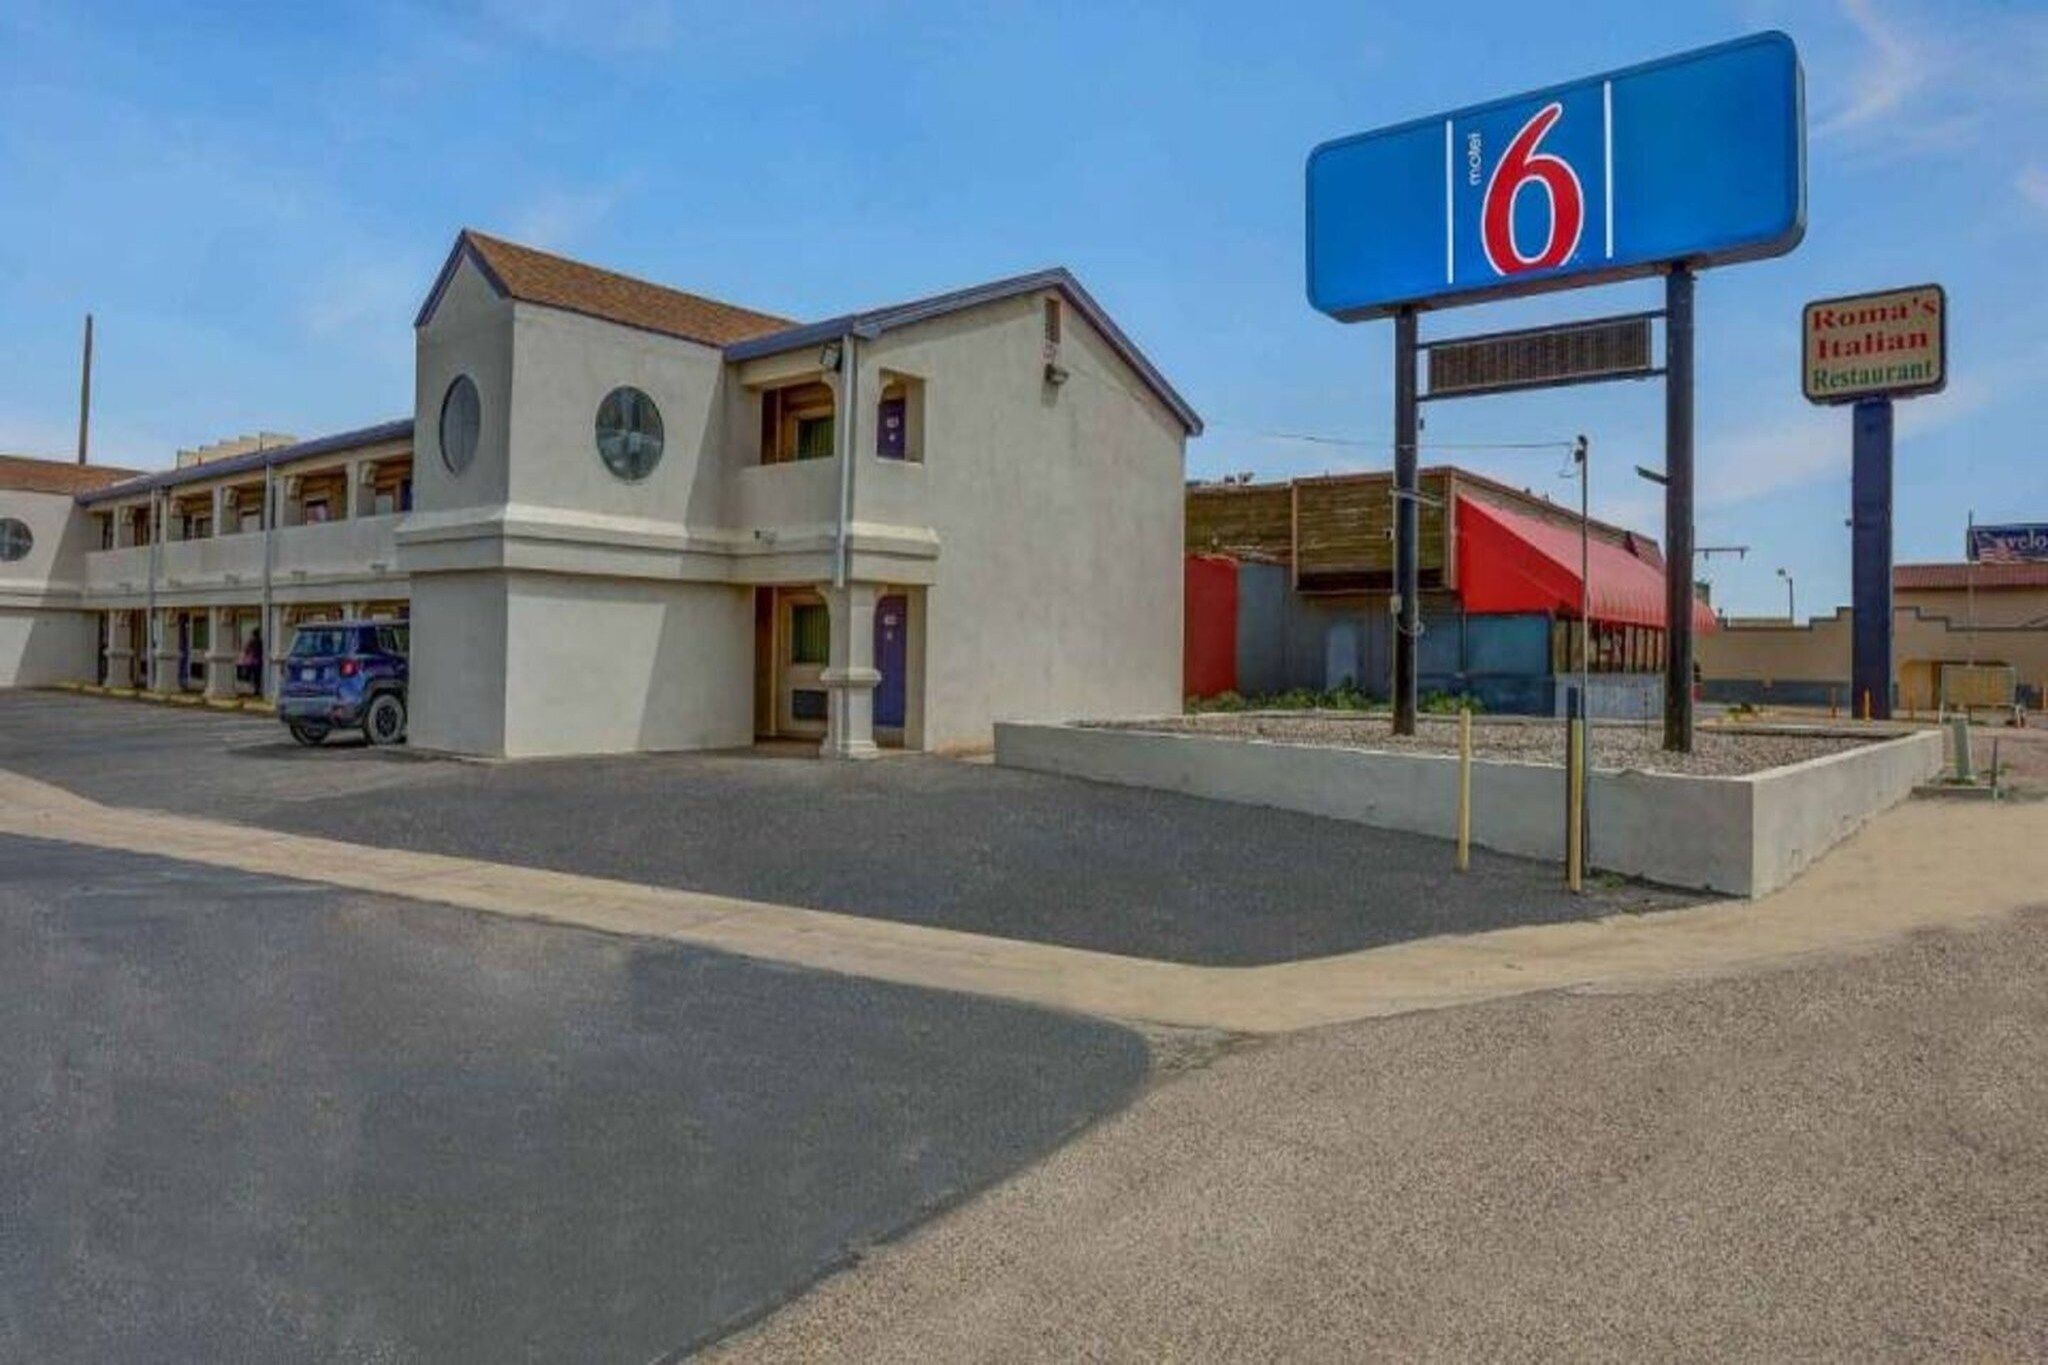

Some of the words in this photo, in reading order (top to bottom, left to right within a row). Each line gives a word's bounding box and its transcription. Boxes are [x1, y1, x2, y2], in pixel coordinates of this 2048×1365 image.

[1468, 132, 1482, 186] motel
[1481, 102, 1584, 276] 6
[1813, 297, 1937, 331] Roma's
[1818, 332, 1928, 360] Italian
[1813, 360, 1933, 391] Restaurant
